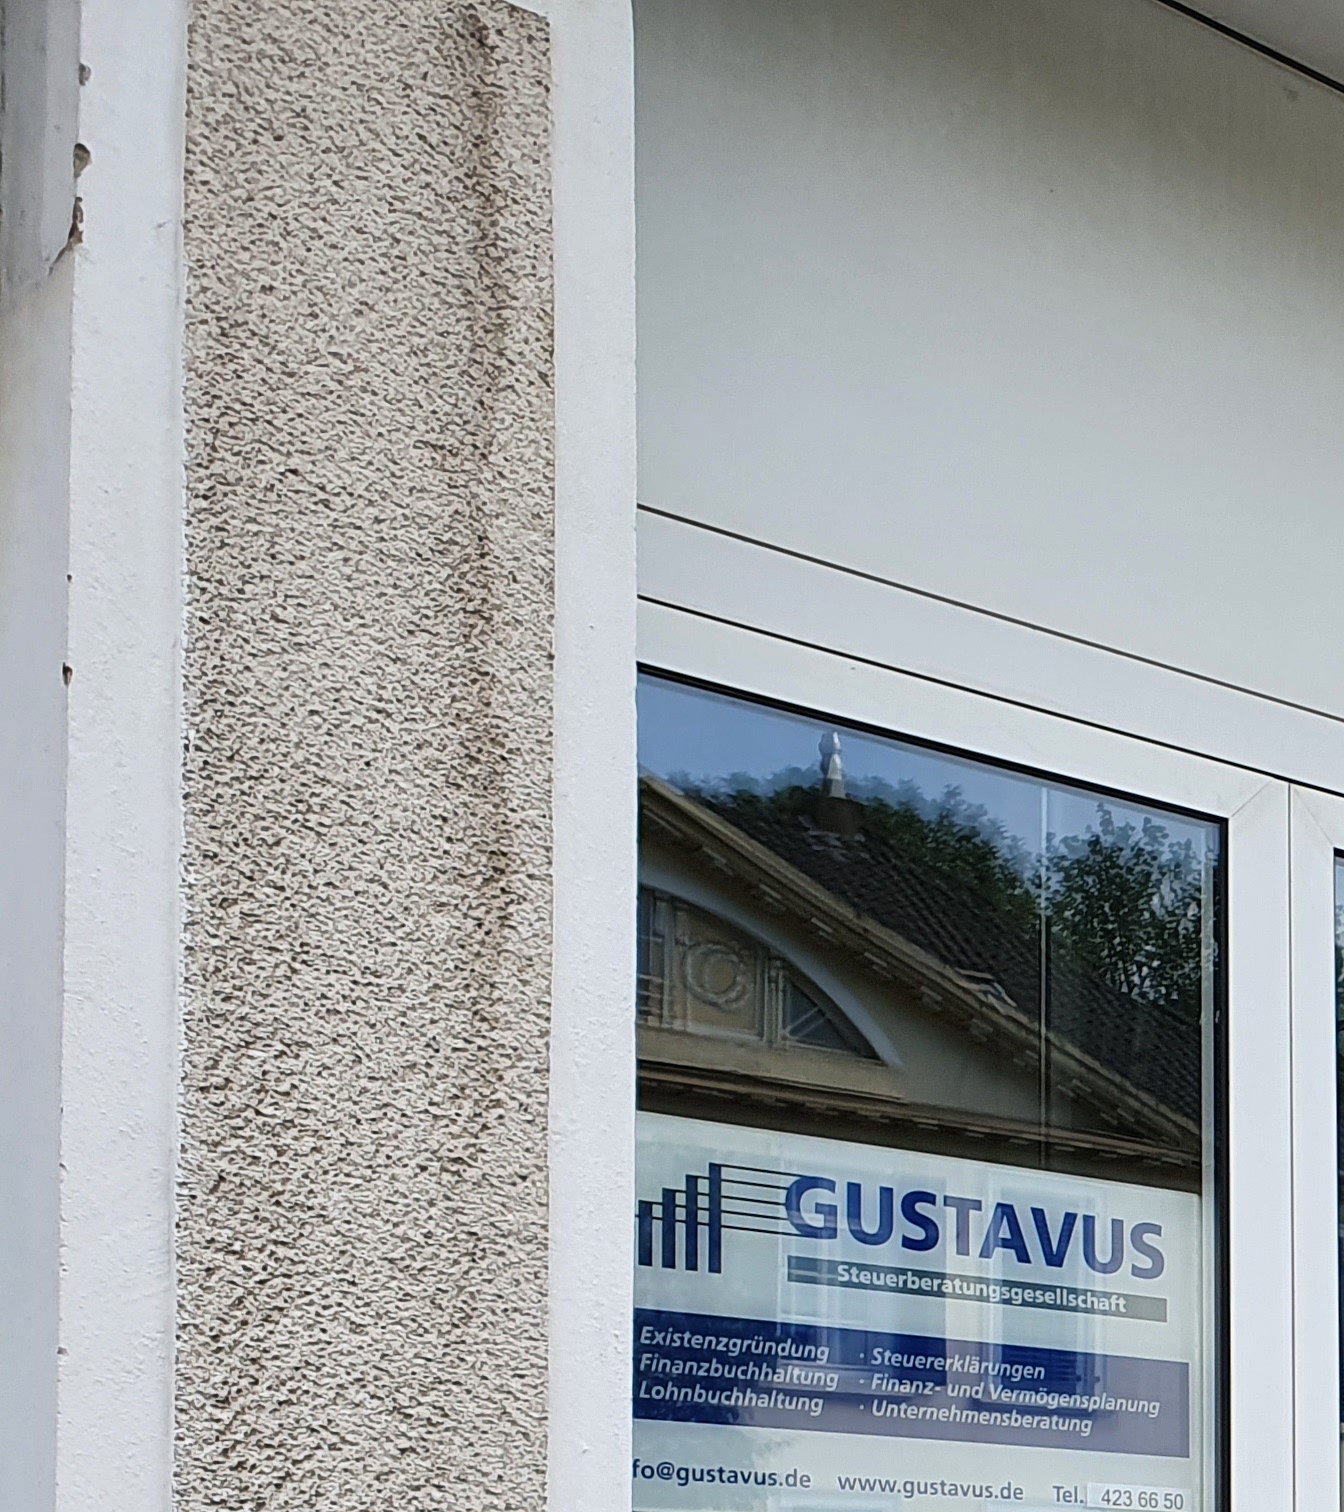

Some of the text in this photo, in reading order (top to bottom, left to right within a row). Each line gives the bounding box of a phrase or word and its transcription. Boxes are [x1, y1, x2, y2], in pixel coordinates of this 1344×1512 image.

[784, 1176, 1166, 1280] GUSTAVUS
[836, 1264, 1127, 1314] Steuerberatungsgesellschaft
[639, 1326, 830, 1363] Existenzgründung
[639, 1353, 840, 1391] Finanzbuchhaltung
[871, 1347, 1046, 1381] Steuererklärungen
[639, 1380, 824, 1416] Lohnbuchhaltung
[871, 1373, 1161, 1418] Finanz- und Vermögensplanung
[872, 1399, 1093, 1437] Unternehmensberatung
[837, 1474, 1024, 1501] www.gustavus.de
[1053, 1485, 1084, 1505] Tel.
[1101, 1489, 1133, 1507] 423
[1137, 1491, 1159, 1509] 66
[1164, 1493, 1184, 1510] 50
